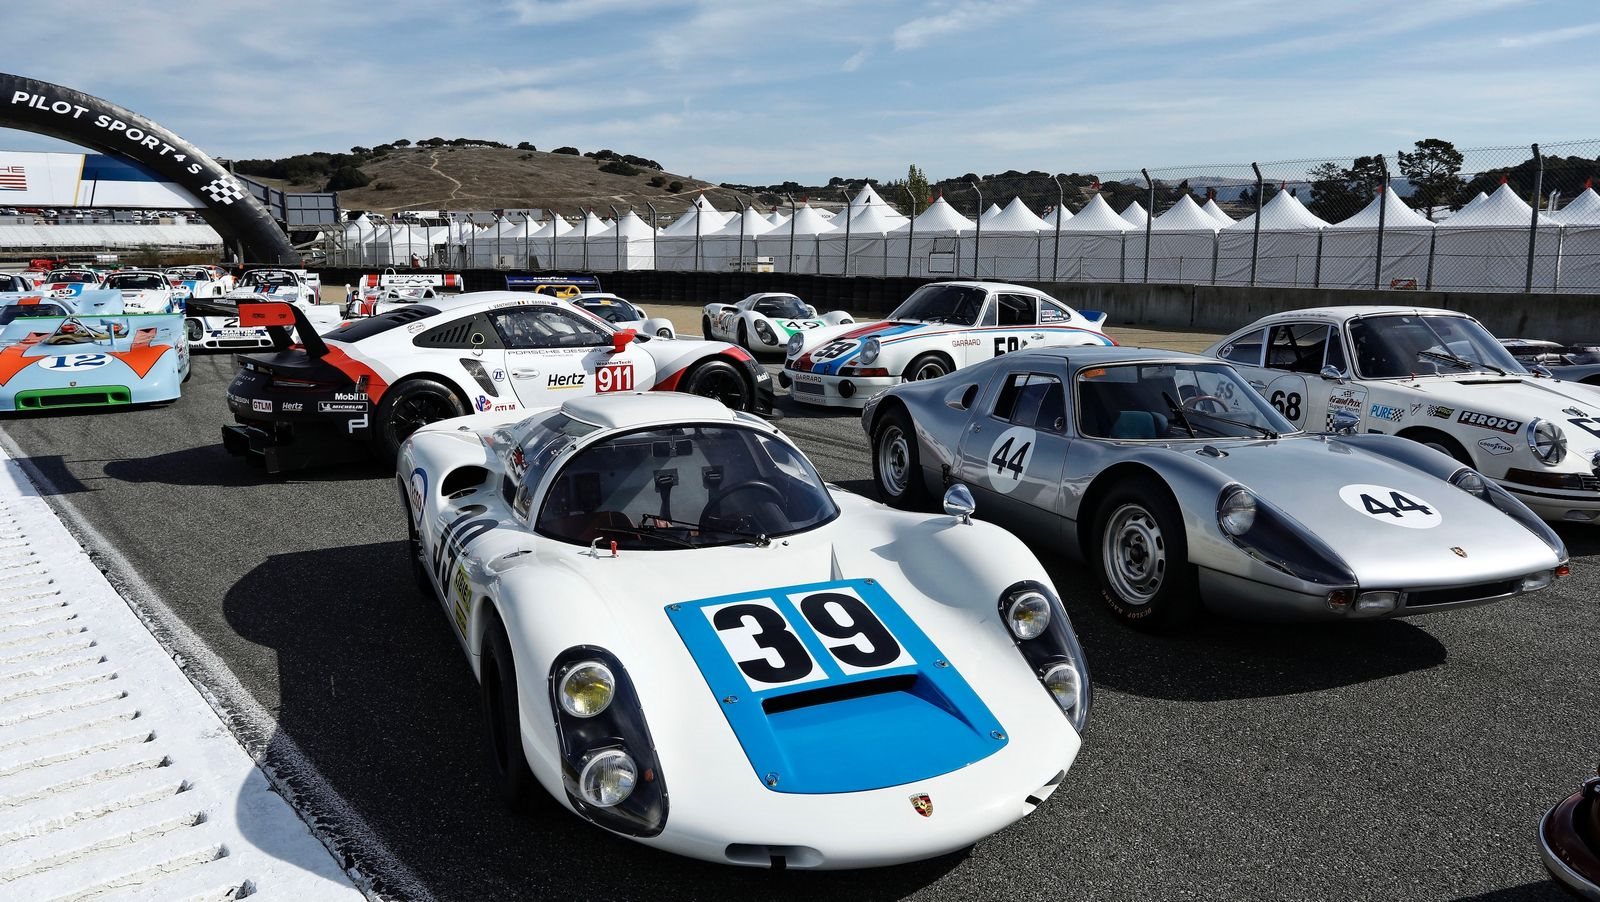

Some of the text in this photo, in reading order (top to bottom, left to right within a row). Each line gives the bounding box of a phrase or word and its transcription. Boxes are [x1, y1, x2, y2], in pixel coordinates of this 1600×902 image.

[11, 91, 89, 119] PILOT
[94, 115, 177, 156] SPORT
[187, 163, 203, 175] S
[223, 317, 239, 328] 2
[787, 321, 820, 329] 49
[814, 341, 858, 359] 59
[952, 338, 981, 347] GARRARD
[50, 354, 106, 369] 12
[547, 373, 586, 386] Hertz
[598, 366, 631, 391] 911
[796, 374, 822, 383] GARRARD
[253, 402, 271, 411] GTLM
[1271, 390, 1302, 421] 68
[1329, 395, 1361, 408] Grand Prix
[1370, 405, 1393, 419] PURE
[1461, 412, 1518, 430] FERODO
[1479, 442, 1511, 451] GOODYEAR
[991, 437, 1032, 481] 44
[1360, 491, 1433, 518] 44
[433, 504, 500, 599] 39
[713, 592, 902, 683] 39
